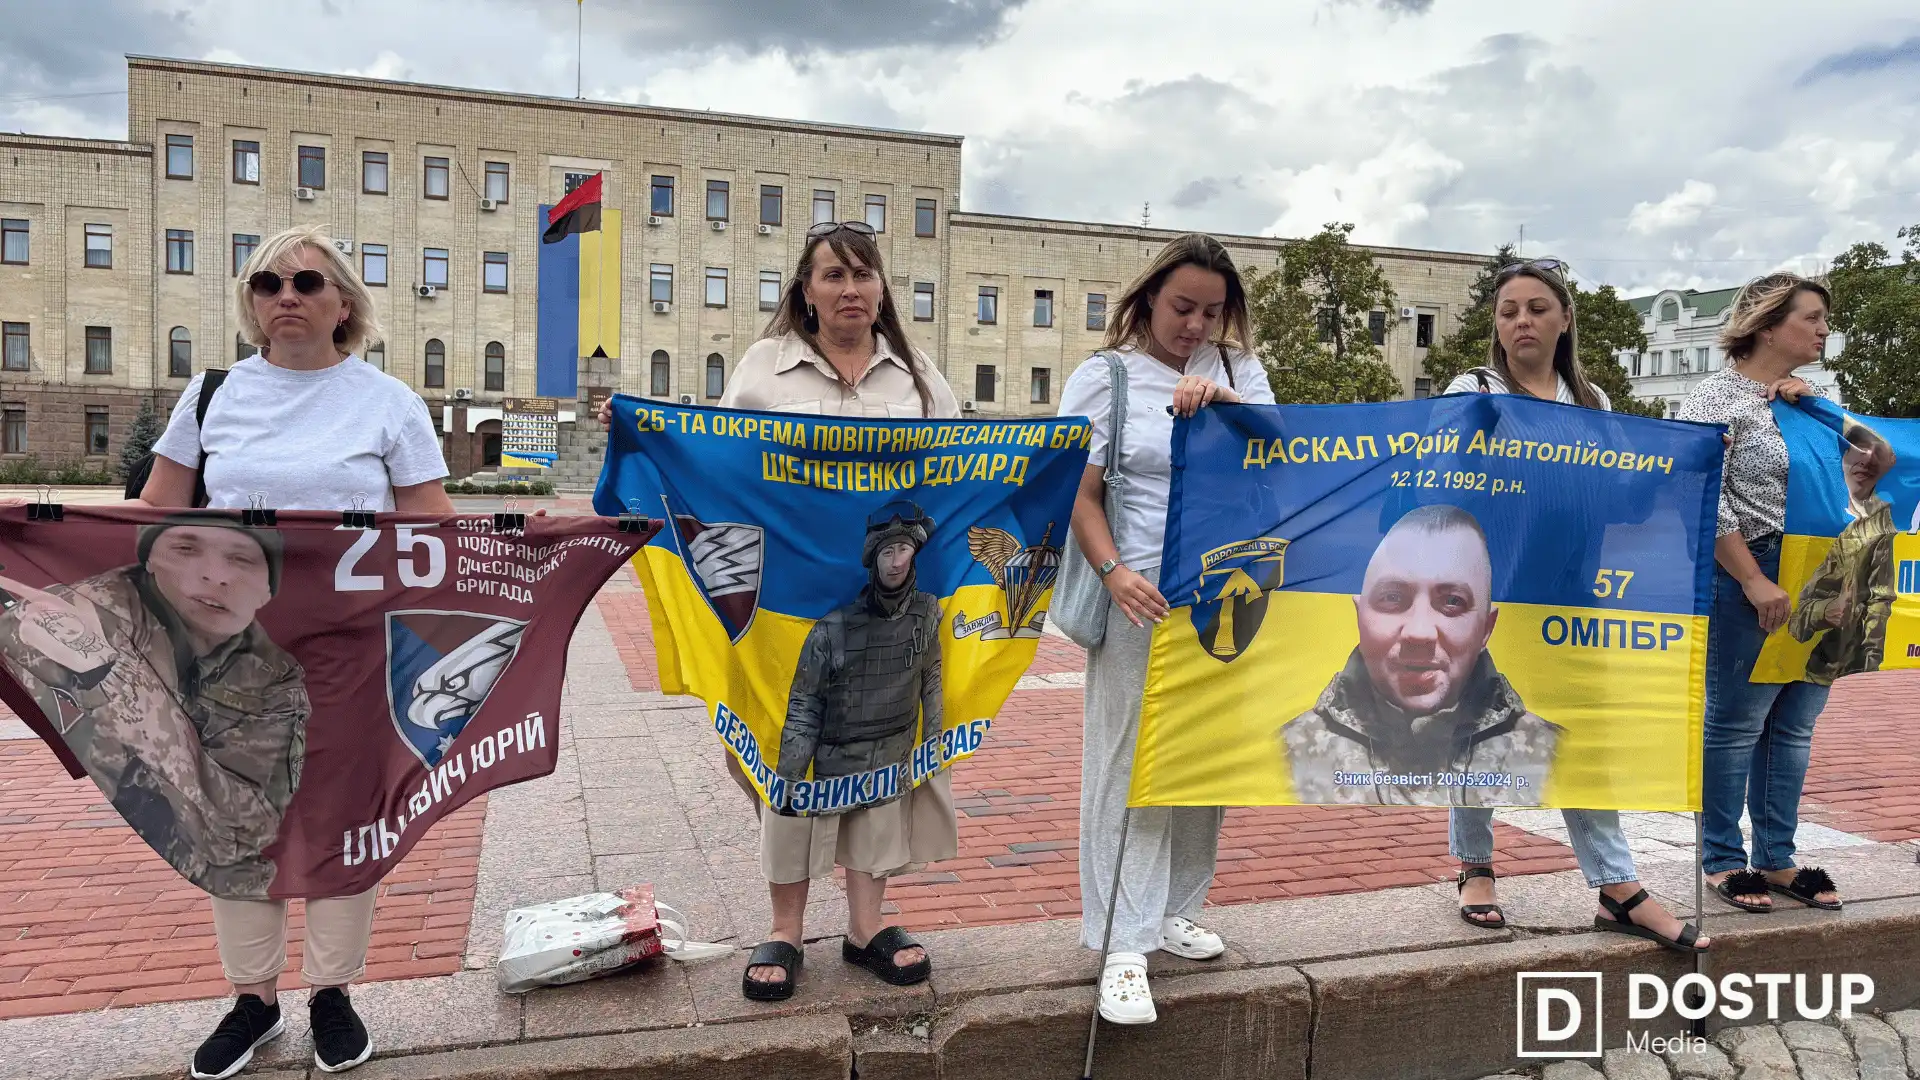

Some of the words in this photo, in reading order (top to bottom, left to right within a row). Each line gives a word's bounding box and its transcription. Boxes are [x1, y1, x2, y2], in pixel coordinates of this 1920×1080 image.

[635, 408, 706, 434] 25-ТА
[712, 415, 806, 449] ОКРЕМА
[812, 425, 1047, 453] ПОВІТРЯНОДЕСАНТНА
[1243, 434, 1379, 469] ДАСКАЛ
[1387, 428, 1461, 460] Юрій
[1466, 429, 1674, 475] Анатолійович
[762, 451, 916, 492] ШЕЛЕПЕНКО
[922, 453, 1029, 486] ЕДУАРД
[1391, 469, 1487, 491] 12.12.1992
[1491, 475, 1527, 496] р.н.
[333, 523, 447, 592] 25
[456, 579, 534, 604] БРИГАДА
[1592, 568, 1635, 599] 57
[962, 614, 995, 635] ЗАВЖДИ
[1541, 615, 1685, 651] ОМПБР
[912, 738, 938, 780] НЕ
[343, 752, 467, 867] ІЛЬВИЧ
[470, 711, 547, 775] ЮРІЙ
[1334, 770, 1371, 786] Зник
[1373, 771, 1433, 786] безвісті
[1436, 772, 1512, 787] 20.05.2024
[1515, 777, 1530, 790] р.
